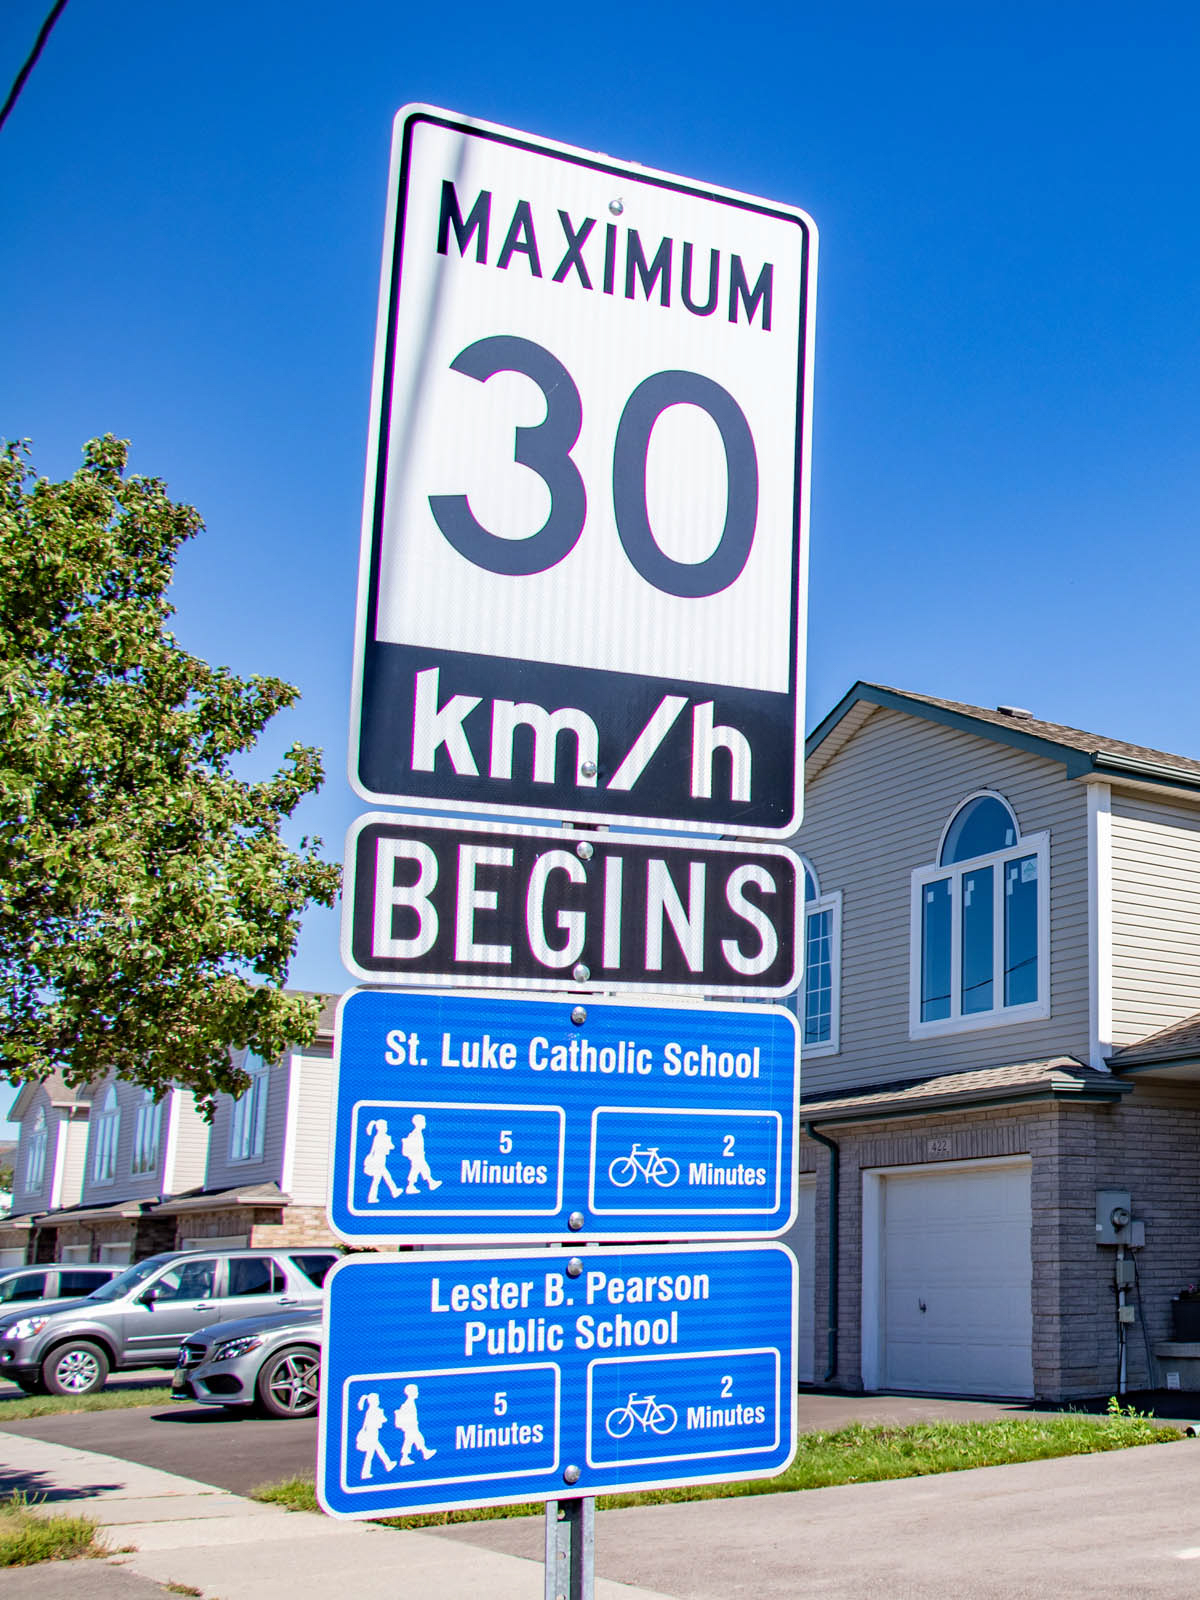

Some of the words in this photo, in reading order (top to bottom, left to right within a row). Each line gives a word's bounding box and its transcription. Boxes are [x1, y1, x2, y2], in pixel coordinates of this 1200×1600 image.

[436, 179, 773, 332] MAXIMUM
[428, 335, 759, 598] 30
[411, 667, 752, 802] km/h
[372, 837, 779, 975] BEGINS
[385, 1029, 428, 1067] St.
[441, 1032, 517, 1070] Luke
[528, 1036, 652, 1075] Catholic
[663, 1042, 760, 1079] School
[499, 1130, 513, 1154] 5
[722, 1135, 735, 1157] 2
[460, 1160, 548, 1185] Minutes
[688, 1162, 767, 1187] Minutes
[430, 1277, 534, 1313] Lester
[545, 1274, 574, 1308] B.
[586, 1272, 709, 1305] Pearson
[465, 1318, 563, 1356] Public
[575, 1311, 678, 1350] School
[720, 1375, 733, 1398] 2
[494, 1392, 508, 1416] 5
[686, 1404, 765, 1430] Minutes
[455, 1423, 544, 1450] Minutes
